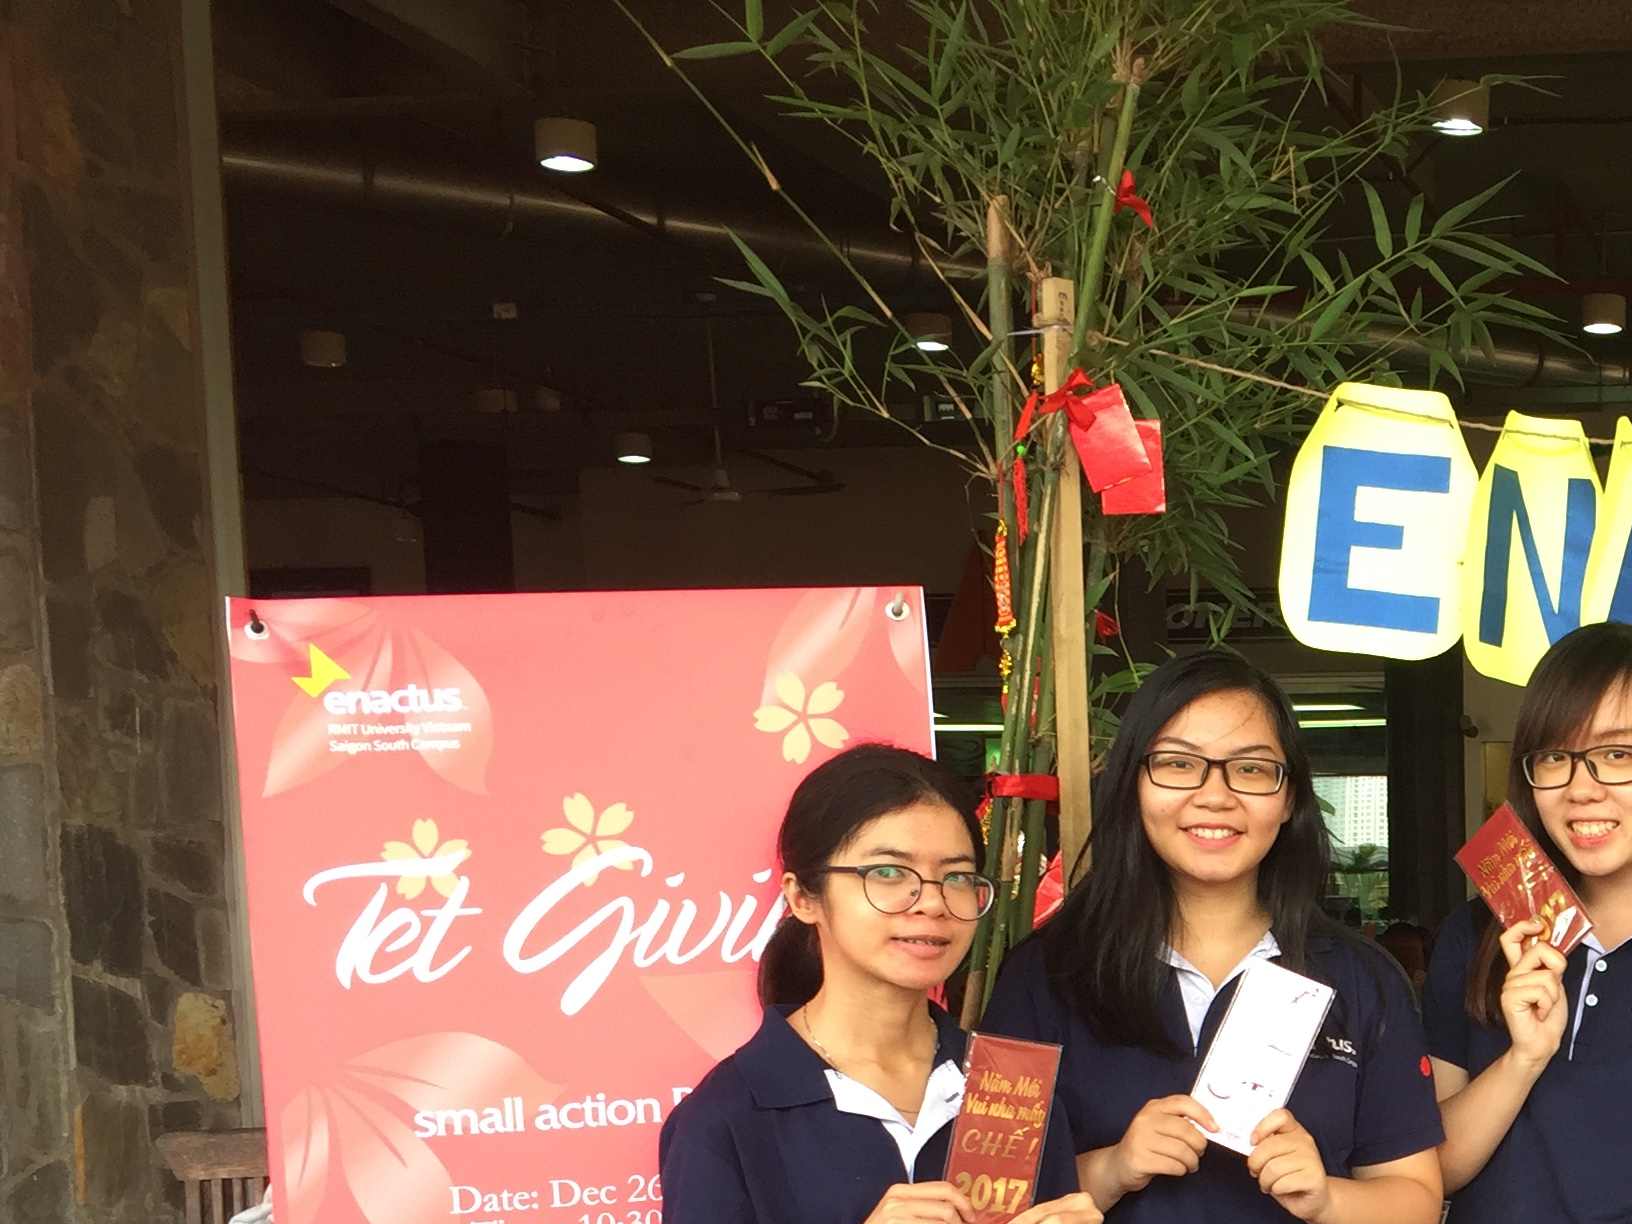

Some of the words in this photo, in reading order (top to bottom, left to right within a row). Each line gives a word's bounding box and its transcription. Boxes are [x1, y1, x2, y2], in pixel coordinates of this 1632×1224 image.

[323, 683, 465, 715] enactus
[302, 849, 484, 991] Tet
[414, 1096, 525, 1138] small
[534, 1092, 663, 1131] action
[449, 1184, 539, 1215] Date:
[549, 1178, 617, 1208] Dec
[955, 1171, 1029, 1215] 2017
